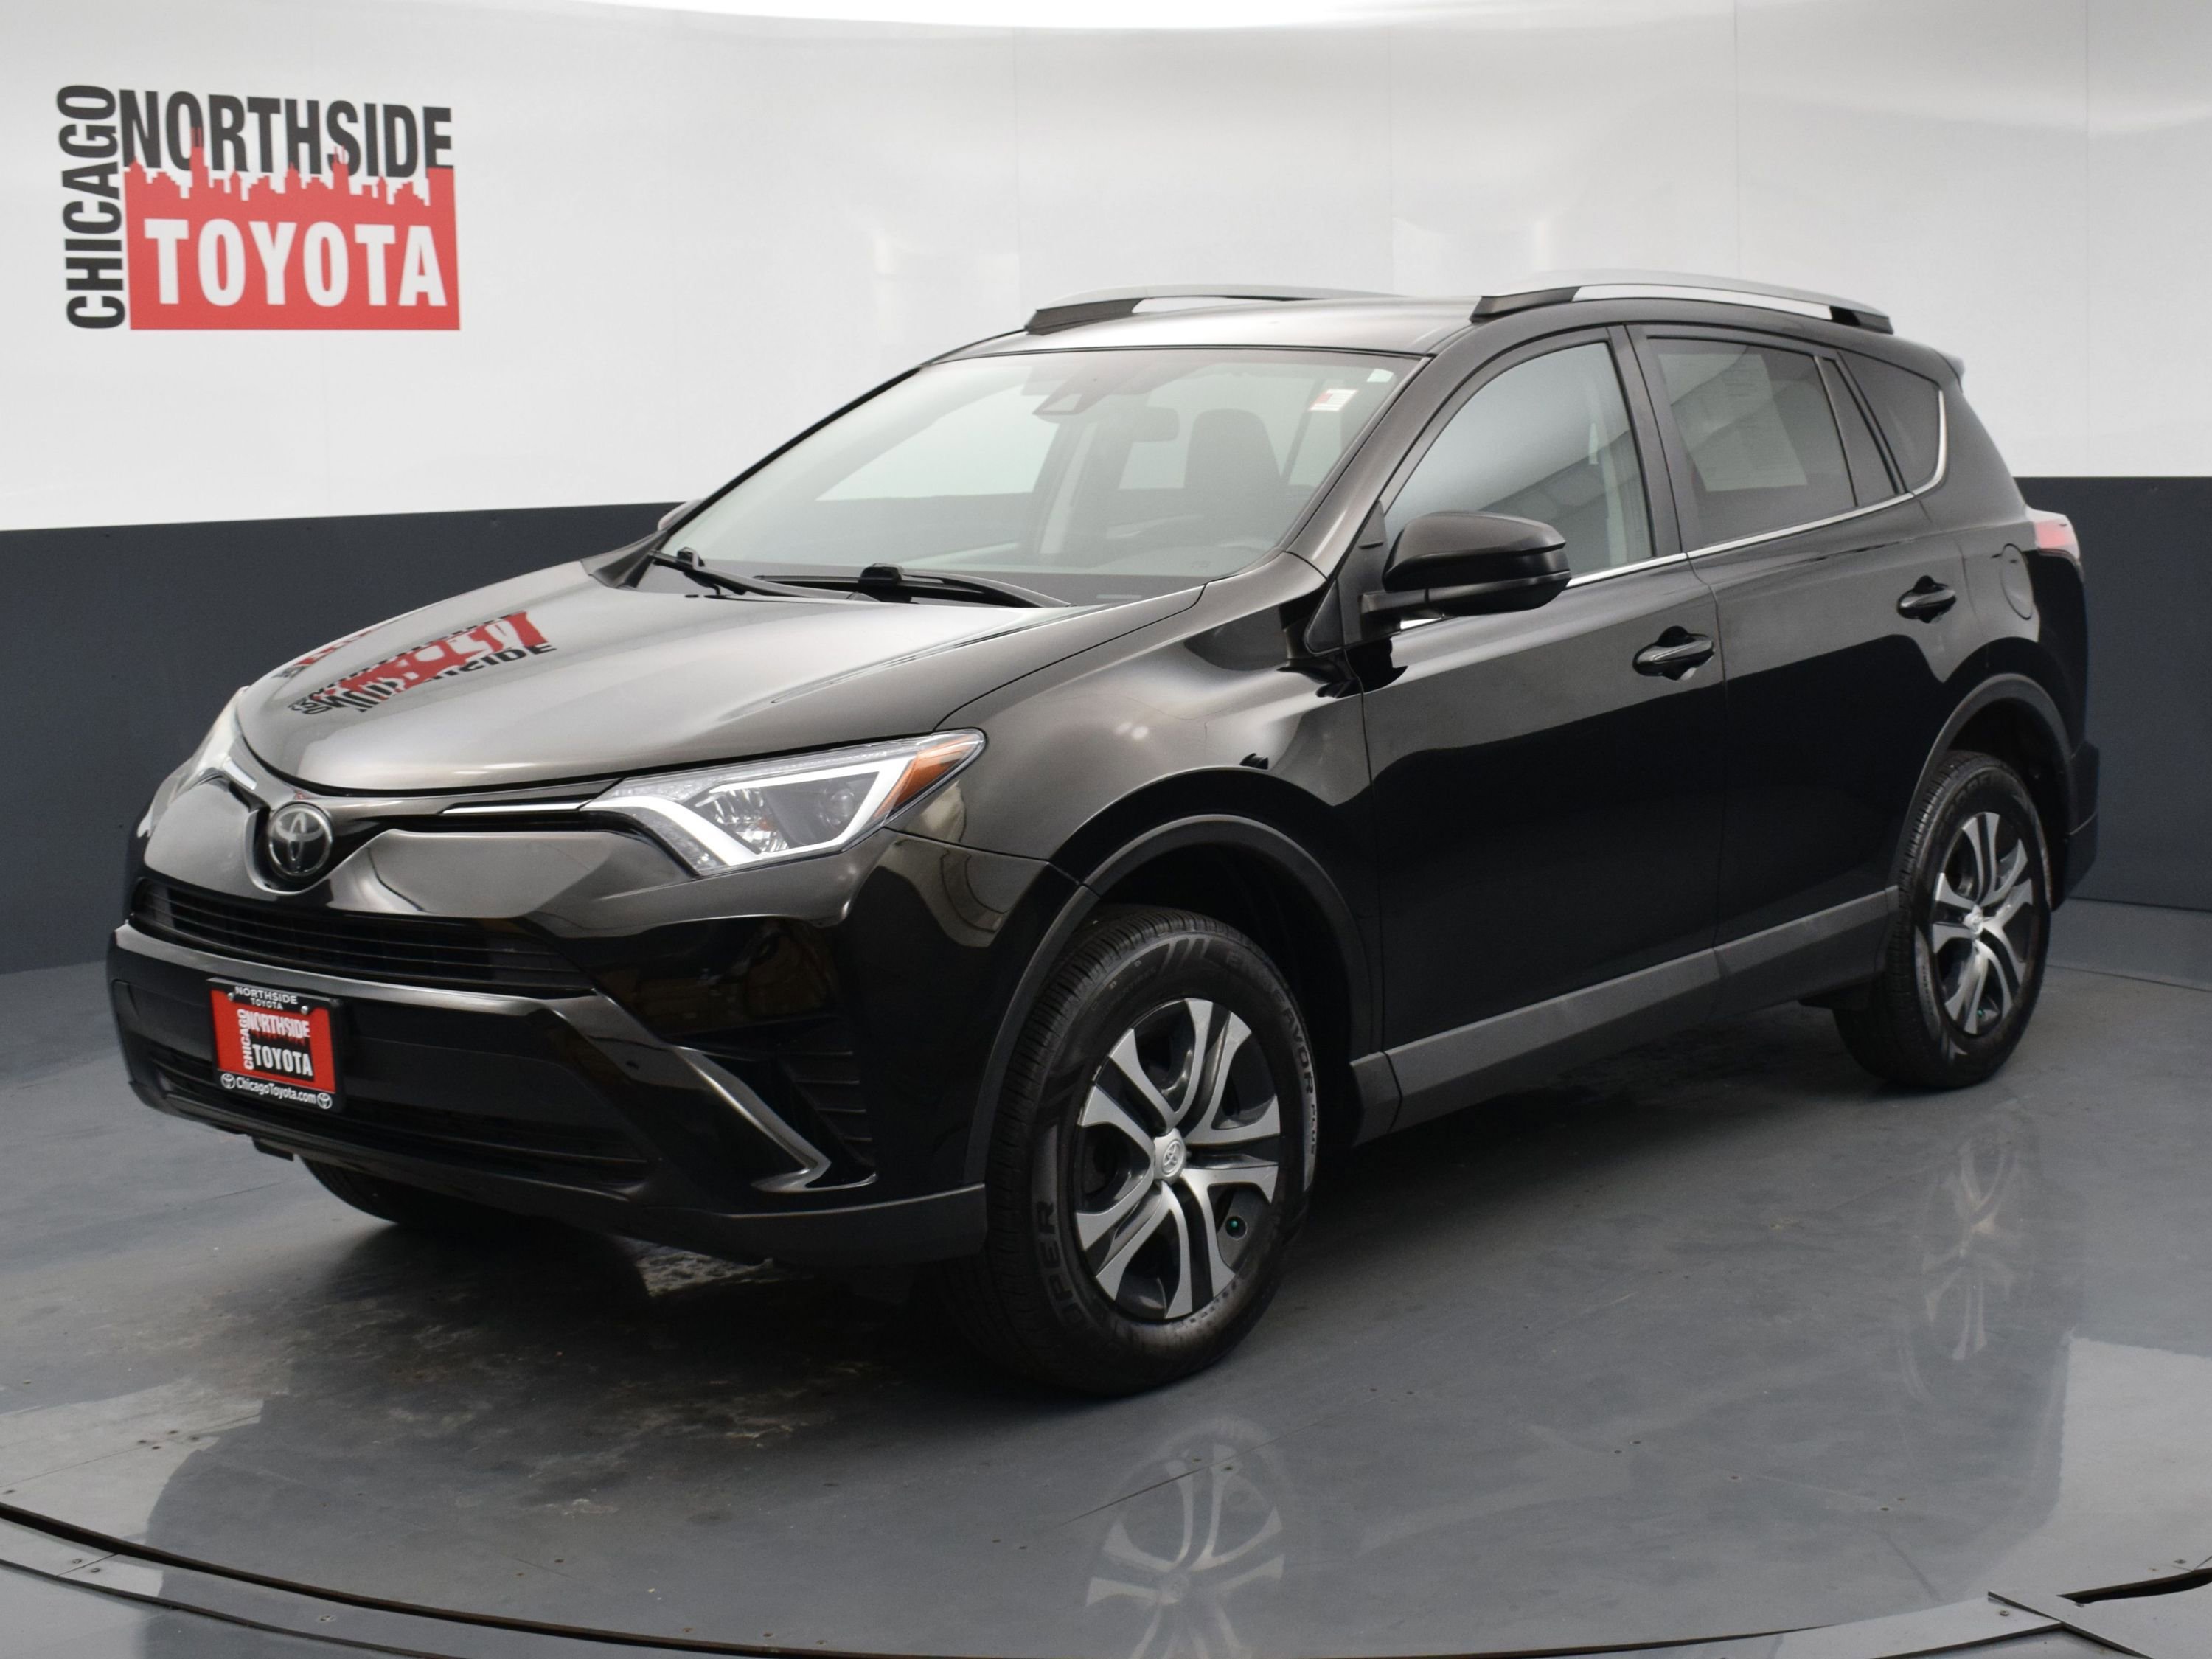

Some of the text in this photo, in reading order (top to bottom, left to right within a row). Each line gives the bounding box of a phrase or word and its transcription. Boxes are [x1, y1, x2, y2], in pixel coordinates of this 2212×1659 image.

[119, 89, 453, 178] NORTHSIDE
[57, 85, 125, 329] CHICAGO
[144, 218, 448, 307] TOYOTA
[234, 986, 299, 1004] NORTHSIDE
[250, 998, 283, 1010] TOYOTA
[237, 1008, 254, 1070] CHICAGO
[246, 1011, 310, 1038] NORTHSIDE
[251, 1043, 313, 1077] TOYOTA
[236, 1077, 316, 1104] ChicagoToyota.com
